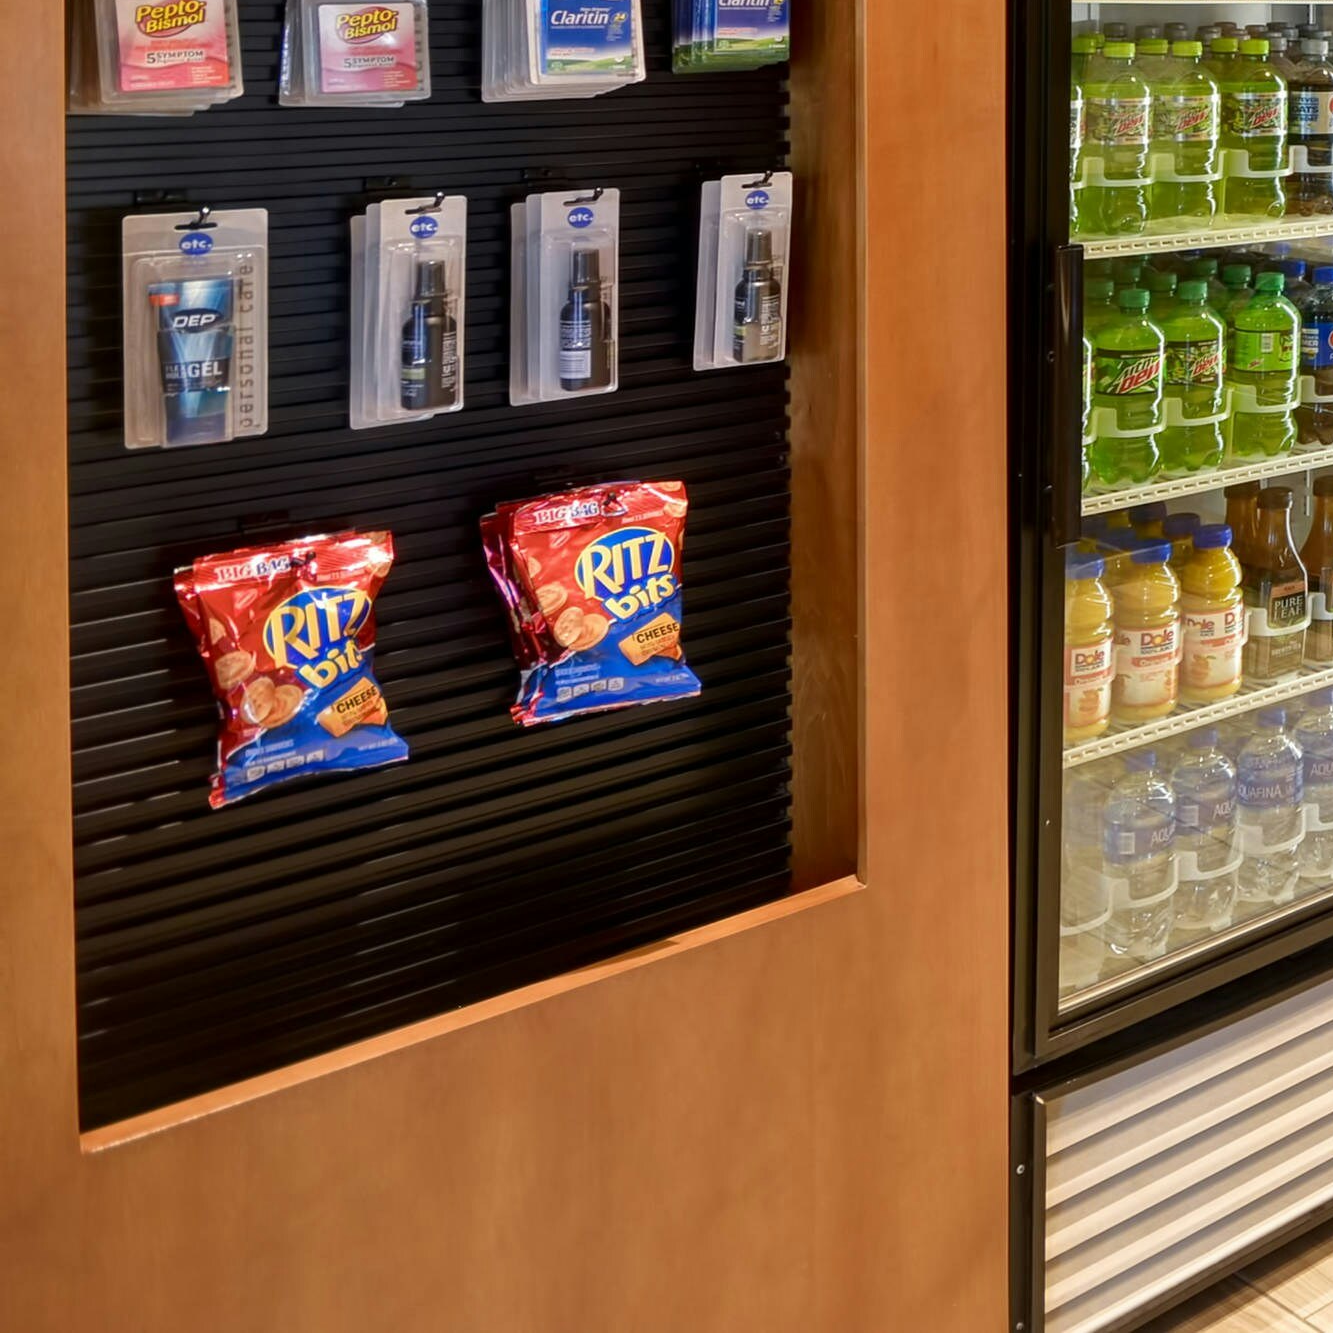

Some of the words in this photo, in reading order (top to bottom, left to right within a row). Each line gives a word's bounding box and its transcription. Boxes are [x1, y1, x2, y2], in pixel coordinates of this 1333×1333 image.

[144, 10, 207, 34] Bismol
[335, 8, 399, 30] Pepto-
[550, 9, 609, 26] Claritin
[343, 19, 398, 41] Bismol
[146, 52, 156, 65] 5
[156, 49, 205, 61] SYMPTOM
[344, 57, 352, 69] 5
[352, 55, 396, 67] SYMPTOM
[746, 195, 769, 206] etc.
[568, 212, 594, 224] etc.
[411, 222, 438, 233] etc.
[181, 239, 213, 252] etc.
[238, 263, 254, 314] care
[172, 313, 217, 329] DEP
[238, 325, 254, 428] personal
[534, 510, 567, 526] BIG
[215, 565, 253, 583] BIG
[256, 556, 291, 576] BAG
[581, 532, 671, 601] RITZ
[604, 574, 675, 619] bits
[1274, 594, 1304, 610] PURE
[1274, 606, 1304, 620] LEAF
[270, 592, 370, 669] RITZ
[636, 622, 680, 644] CHEESE
[1141, 629, 1174, 646] Dole
[1075, 650, 1105, 666] Dole
[335, 686, 378, 714] CHEESE
